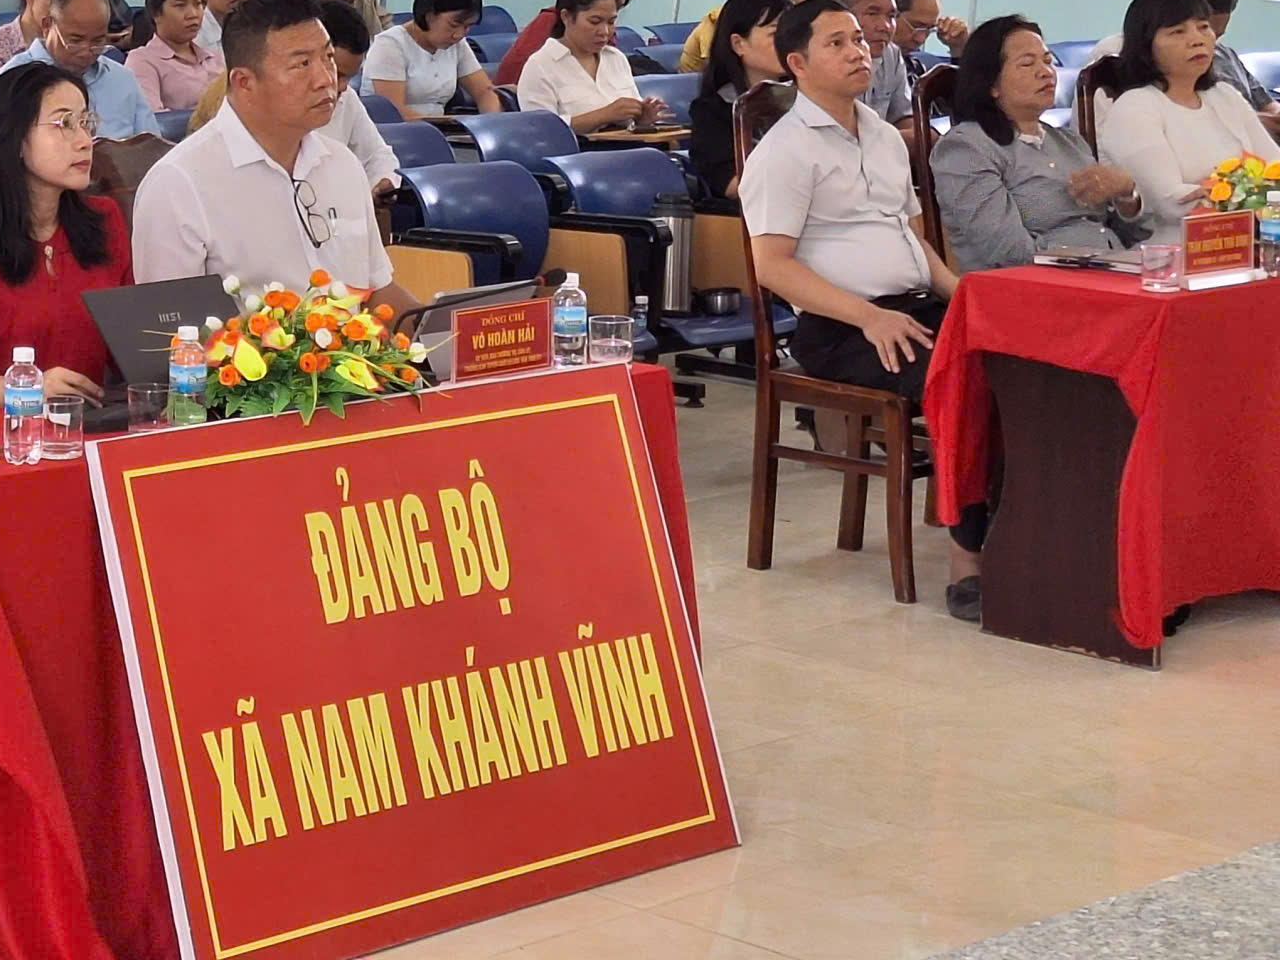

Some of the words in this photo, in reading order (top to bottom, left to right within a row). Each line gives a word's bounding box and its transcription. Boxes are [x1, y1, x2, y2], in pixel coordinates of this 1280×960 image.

[472, 331, 485, 350] VÕ
[488, 328, 515, 347] HOÀN
[518, 322, 535, 343] HẢI
[482, 313, 507, 326] ĐỒNG
[509, 310, 525, 321] CHÍ
[304, 466, 445, 625] ĐẢNG
[437, 458, 512, 616] BỘ
[201, 695, 288, 852] XÃ
[280, 692, 408, 830] NAM
[401, 646, 568, 799] KHÁNH
[558, 622, 674, 757] VĨNH
